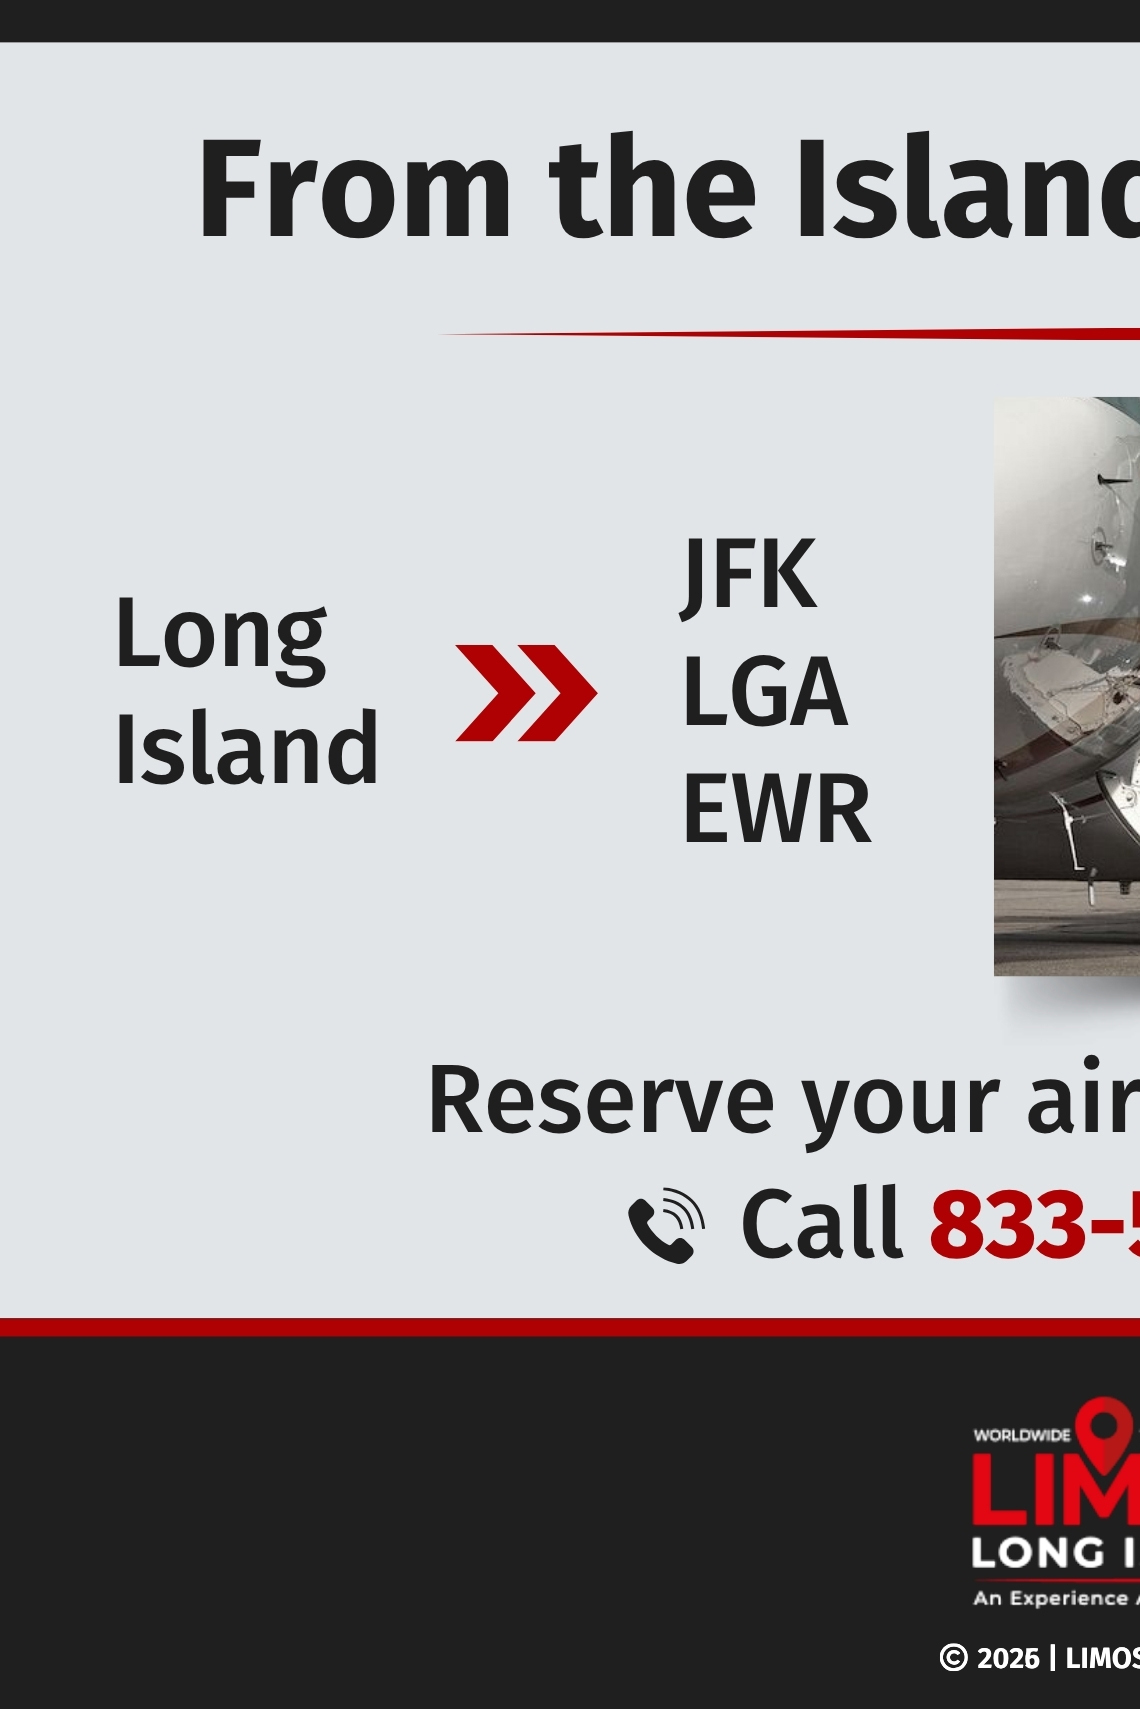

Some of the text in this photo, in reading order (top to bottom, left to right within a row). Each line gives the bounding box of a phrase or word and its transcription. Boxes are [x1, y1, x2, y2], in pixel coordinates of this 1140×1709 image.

[203, 140, 508, 238] From
[549, 131, 755, 238] the
[680, 538, 818, 622] JFK
[116, 597, 327, 688] Long
[685, 655, 848, 727] LGA
[117, 708, 377, 785] Island
[685, 773, 872, 843] EWR
[430, 1065, 773, 1134] Reserve
[801, 1079, 1001, 1153] your
[743, 1184, 904, 1259] Call
[973, 1428, 1071, 1443] WORLDWIDE
[972, 1536, 1104, 1569] LONG
[973, 1590, 1002, 1606] An
[1009, 1590, 1129, 1610] Experience
